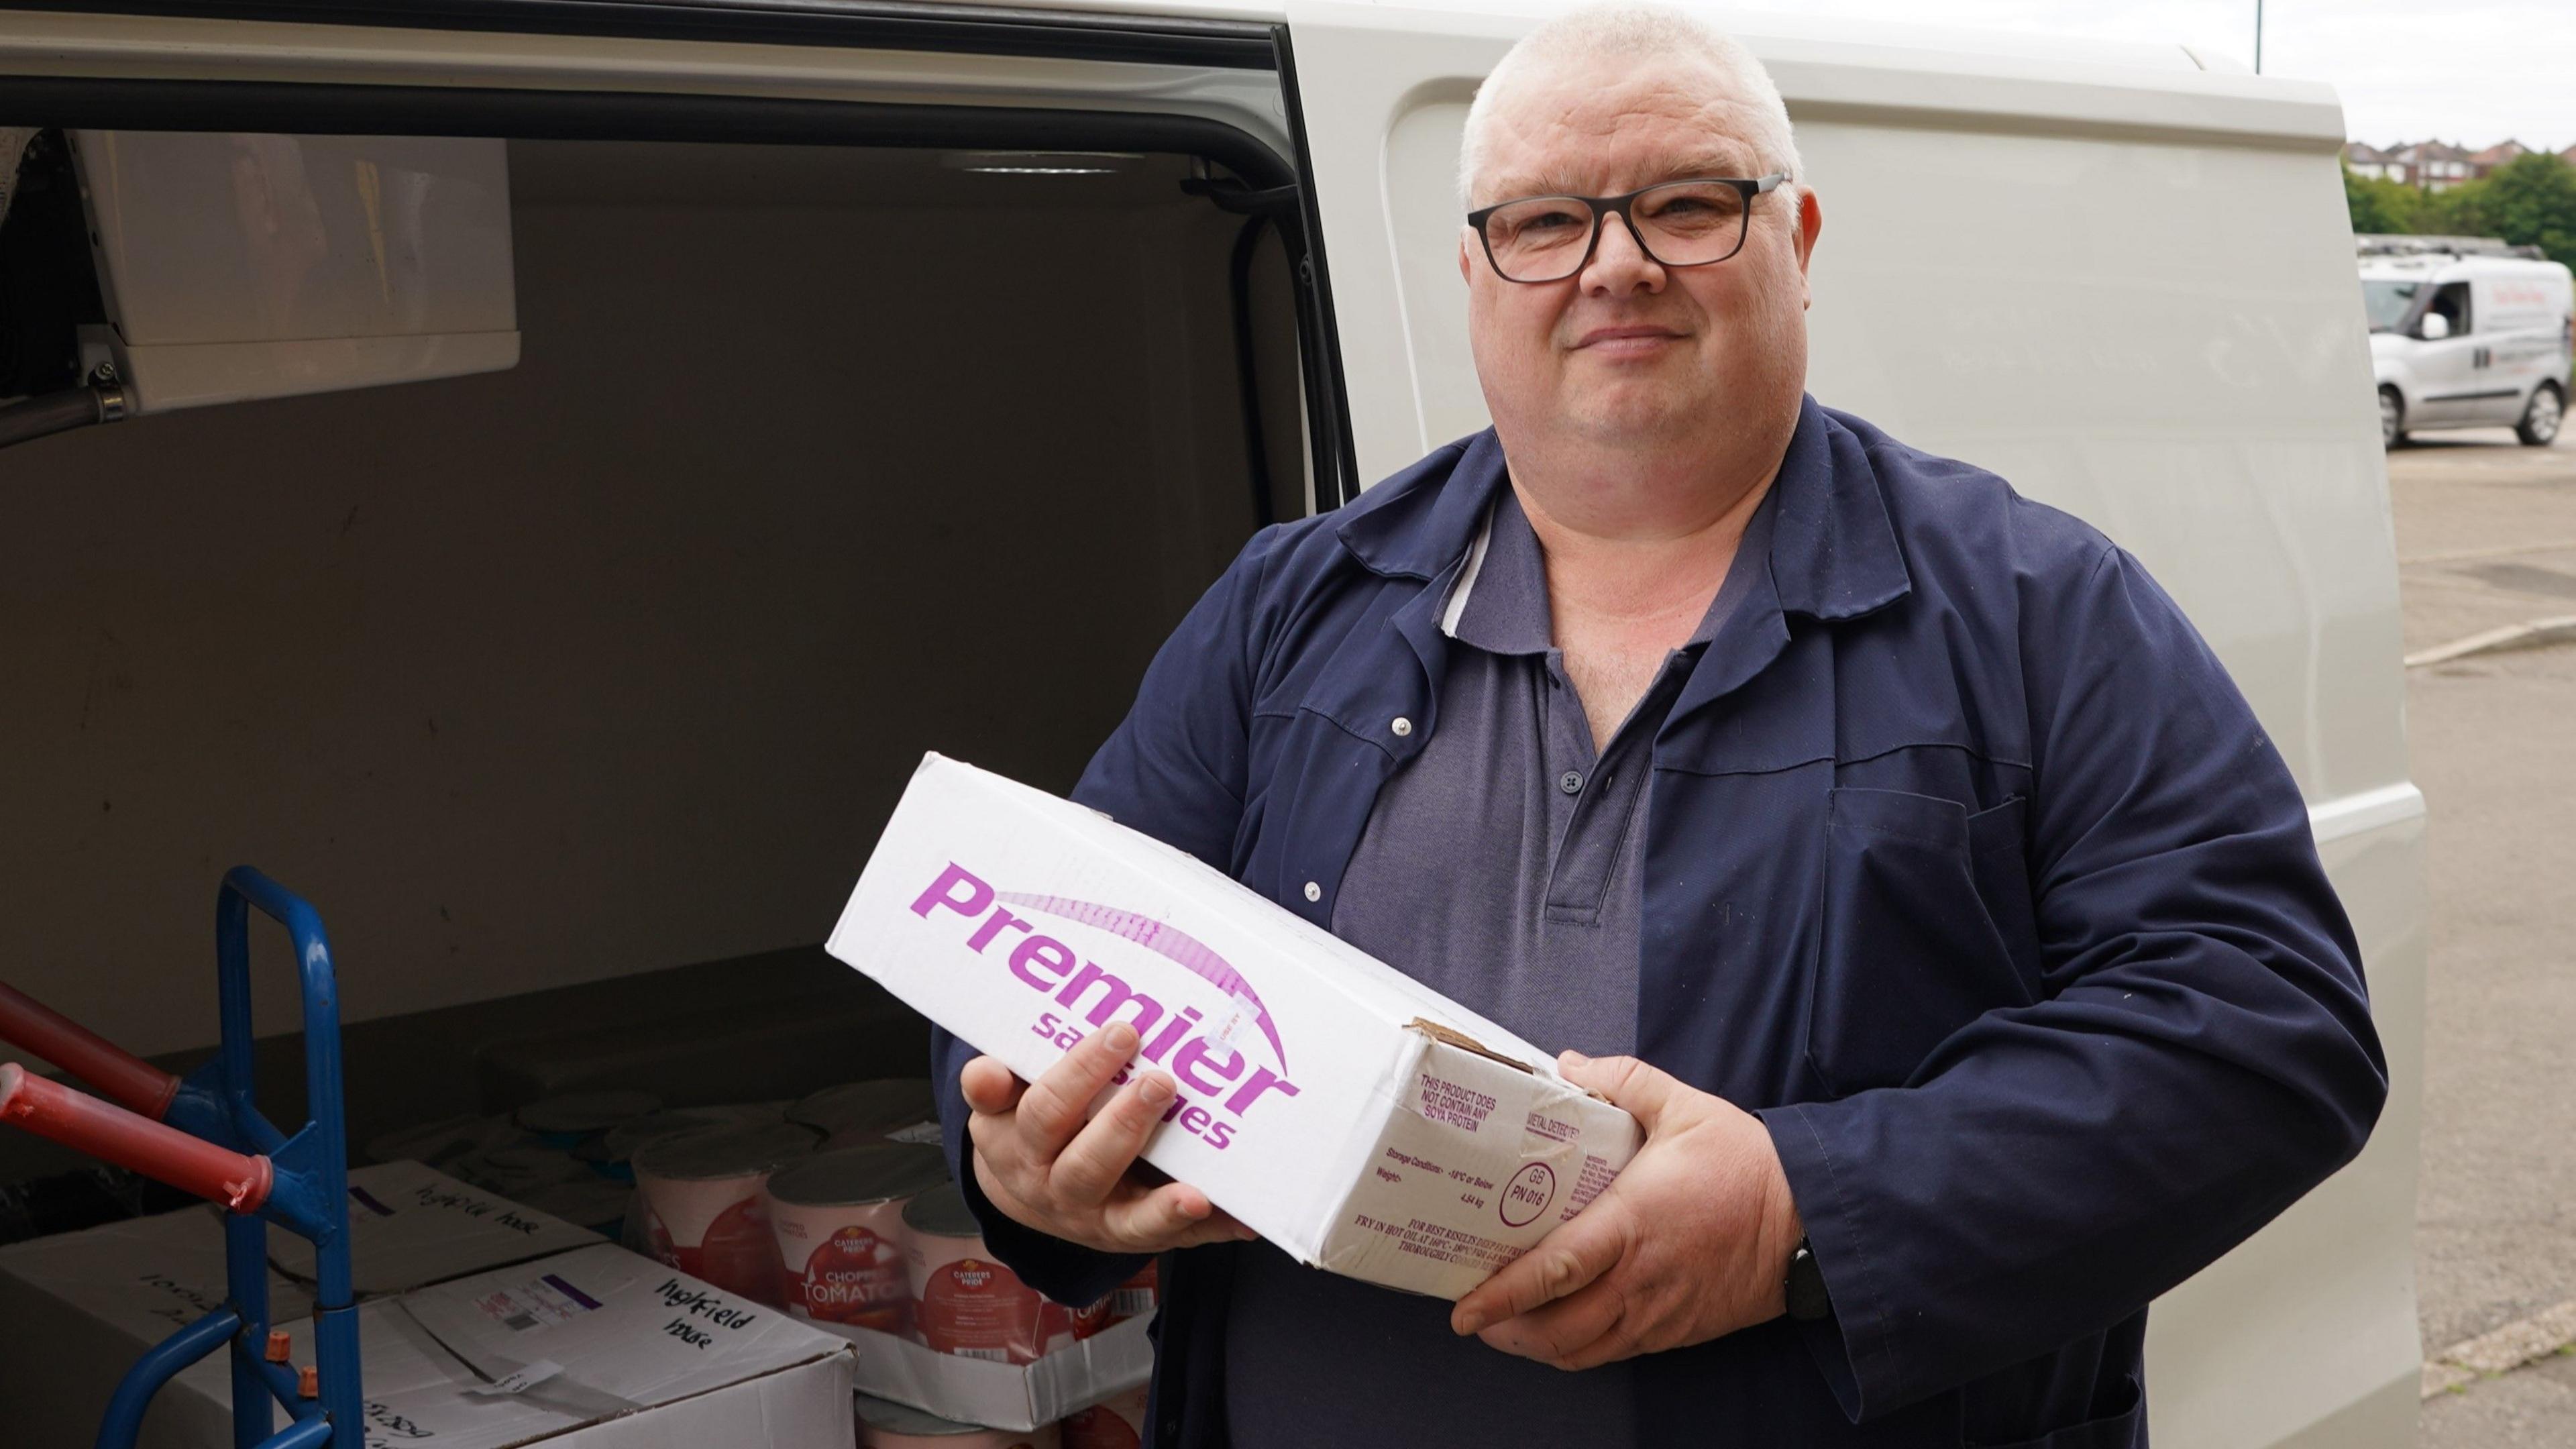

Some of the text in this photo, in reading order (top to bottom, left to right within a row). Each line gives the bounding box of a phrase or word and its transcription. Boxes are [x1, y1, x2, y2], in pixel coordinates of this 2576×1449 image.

[910, 861, 1301, 1118] Premier
[1220, 1012, 1240, 1040] USE BY
[1031, 1013, 1236, 1150] sases
[1421, 1073, 1497, 1111] THIS PRODUCT DOES
[1421, 1089, 1489, 1122] NOT CONTAIN ANY
[1424, 1104, 1479, 1133] SOYA PROTEIN
[1526, 1112, 1580, 1139] METAL DETECTED
[1386, 1146, 1411, 1164] Storage
[1474, 1177, 1494, 1190] Below
[1529, 1169, 1545, 1185] GB
[1475, 1196, 1485, 1210] kg
[1510, 1185, 1545, 1206] PN 016
[1354, 1214, 1377, 1229] FRY
[1374, 1221, 1387, 1232] IN
[1385, 1224, 1405, 1237] HOT
[1403, 1229, 1418, 1242] OIL
[1417, 1234, 1430, 1244] AT
[1408, 1218, 1426, 1232] FOR
[1426, 1223, 1446, 1237] BEST
[1444, 1228, 1478, 1246] RESULTS
[1397, 1240, 1452, 1262] THOROUGHLY
